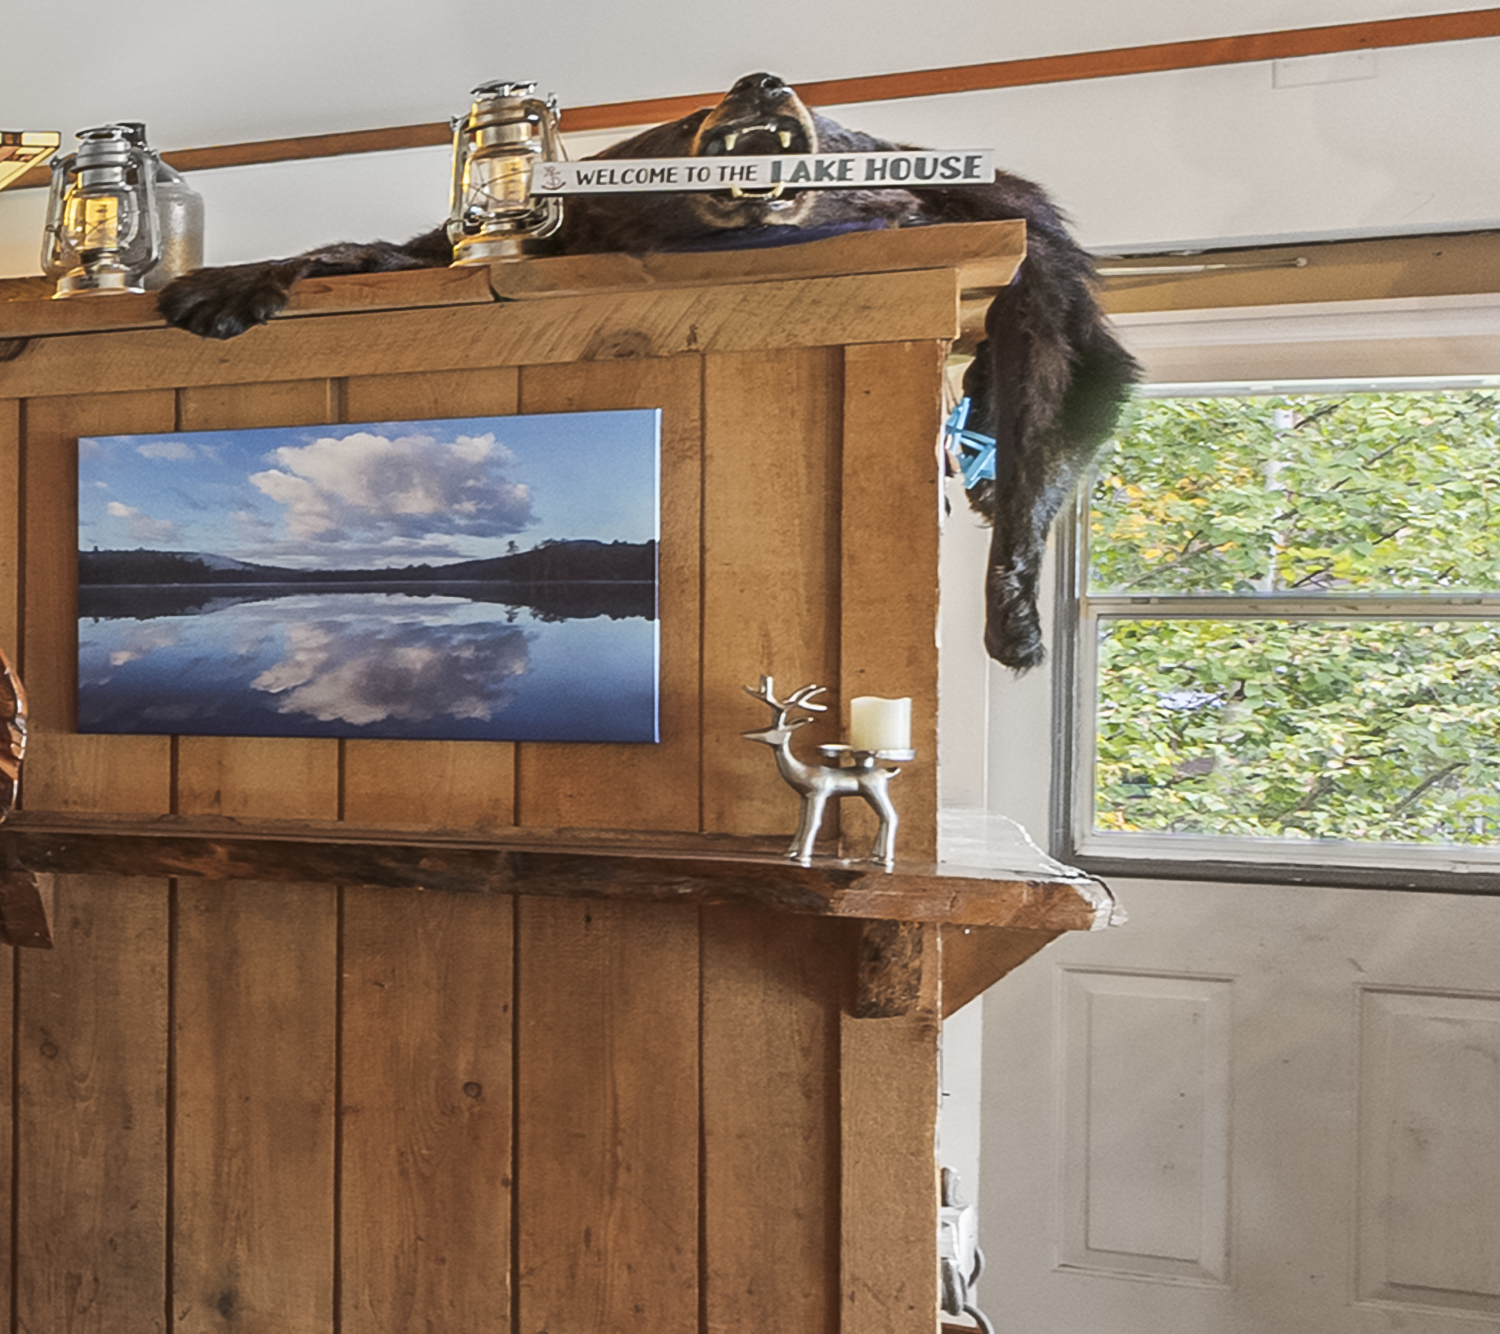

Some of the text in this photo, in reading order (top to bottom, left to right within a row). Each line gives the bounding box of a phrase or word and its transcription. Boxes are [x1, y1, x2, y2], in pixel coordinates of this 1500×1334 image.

[575, 154, 983, 187] WELCOME TO THE LAKE HOUSE
